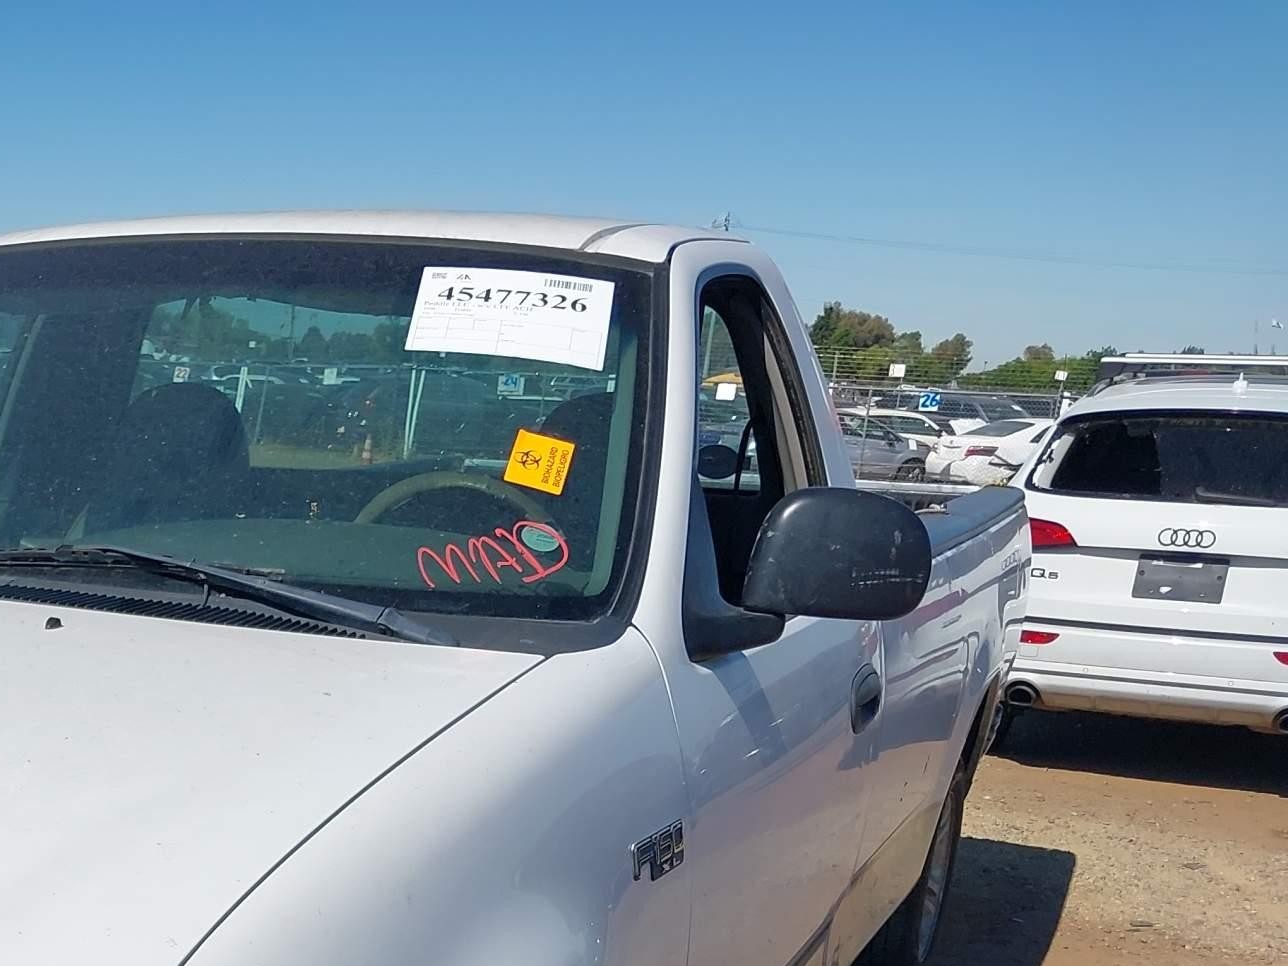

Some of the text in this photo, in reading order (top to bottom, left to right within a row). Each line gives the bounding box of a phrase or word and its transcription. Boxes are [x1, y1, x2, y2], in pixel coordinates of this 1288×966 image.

[438, 286, 587, 313] 45477326
[921, 394, 941, 408] 26
[542, 446, 559, 484] BIOHAZARD
[552, 449, 570, 488] BIOPELIGRO
[1031, 567, 1059, 580] Q5
